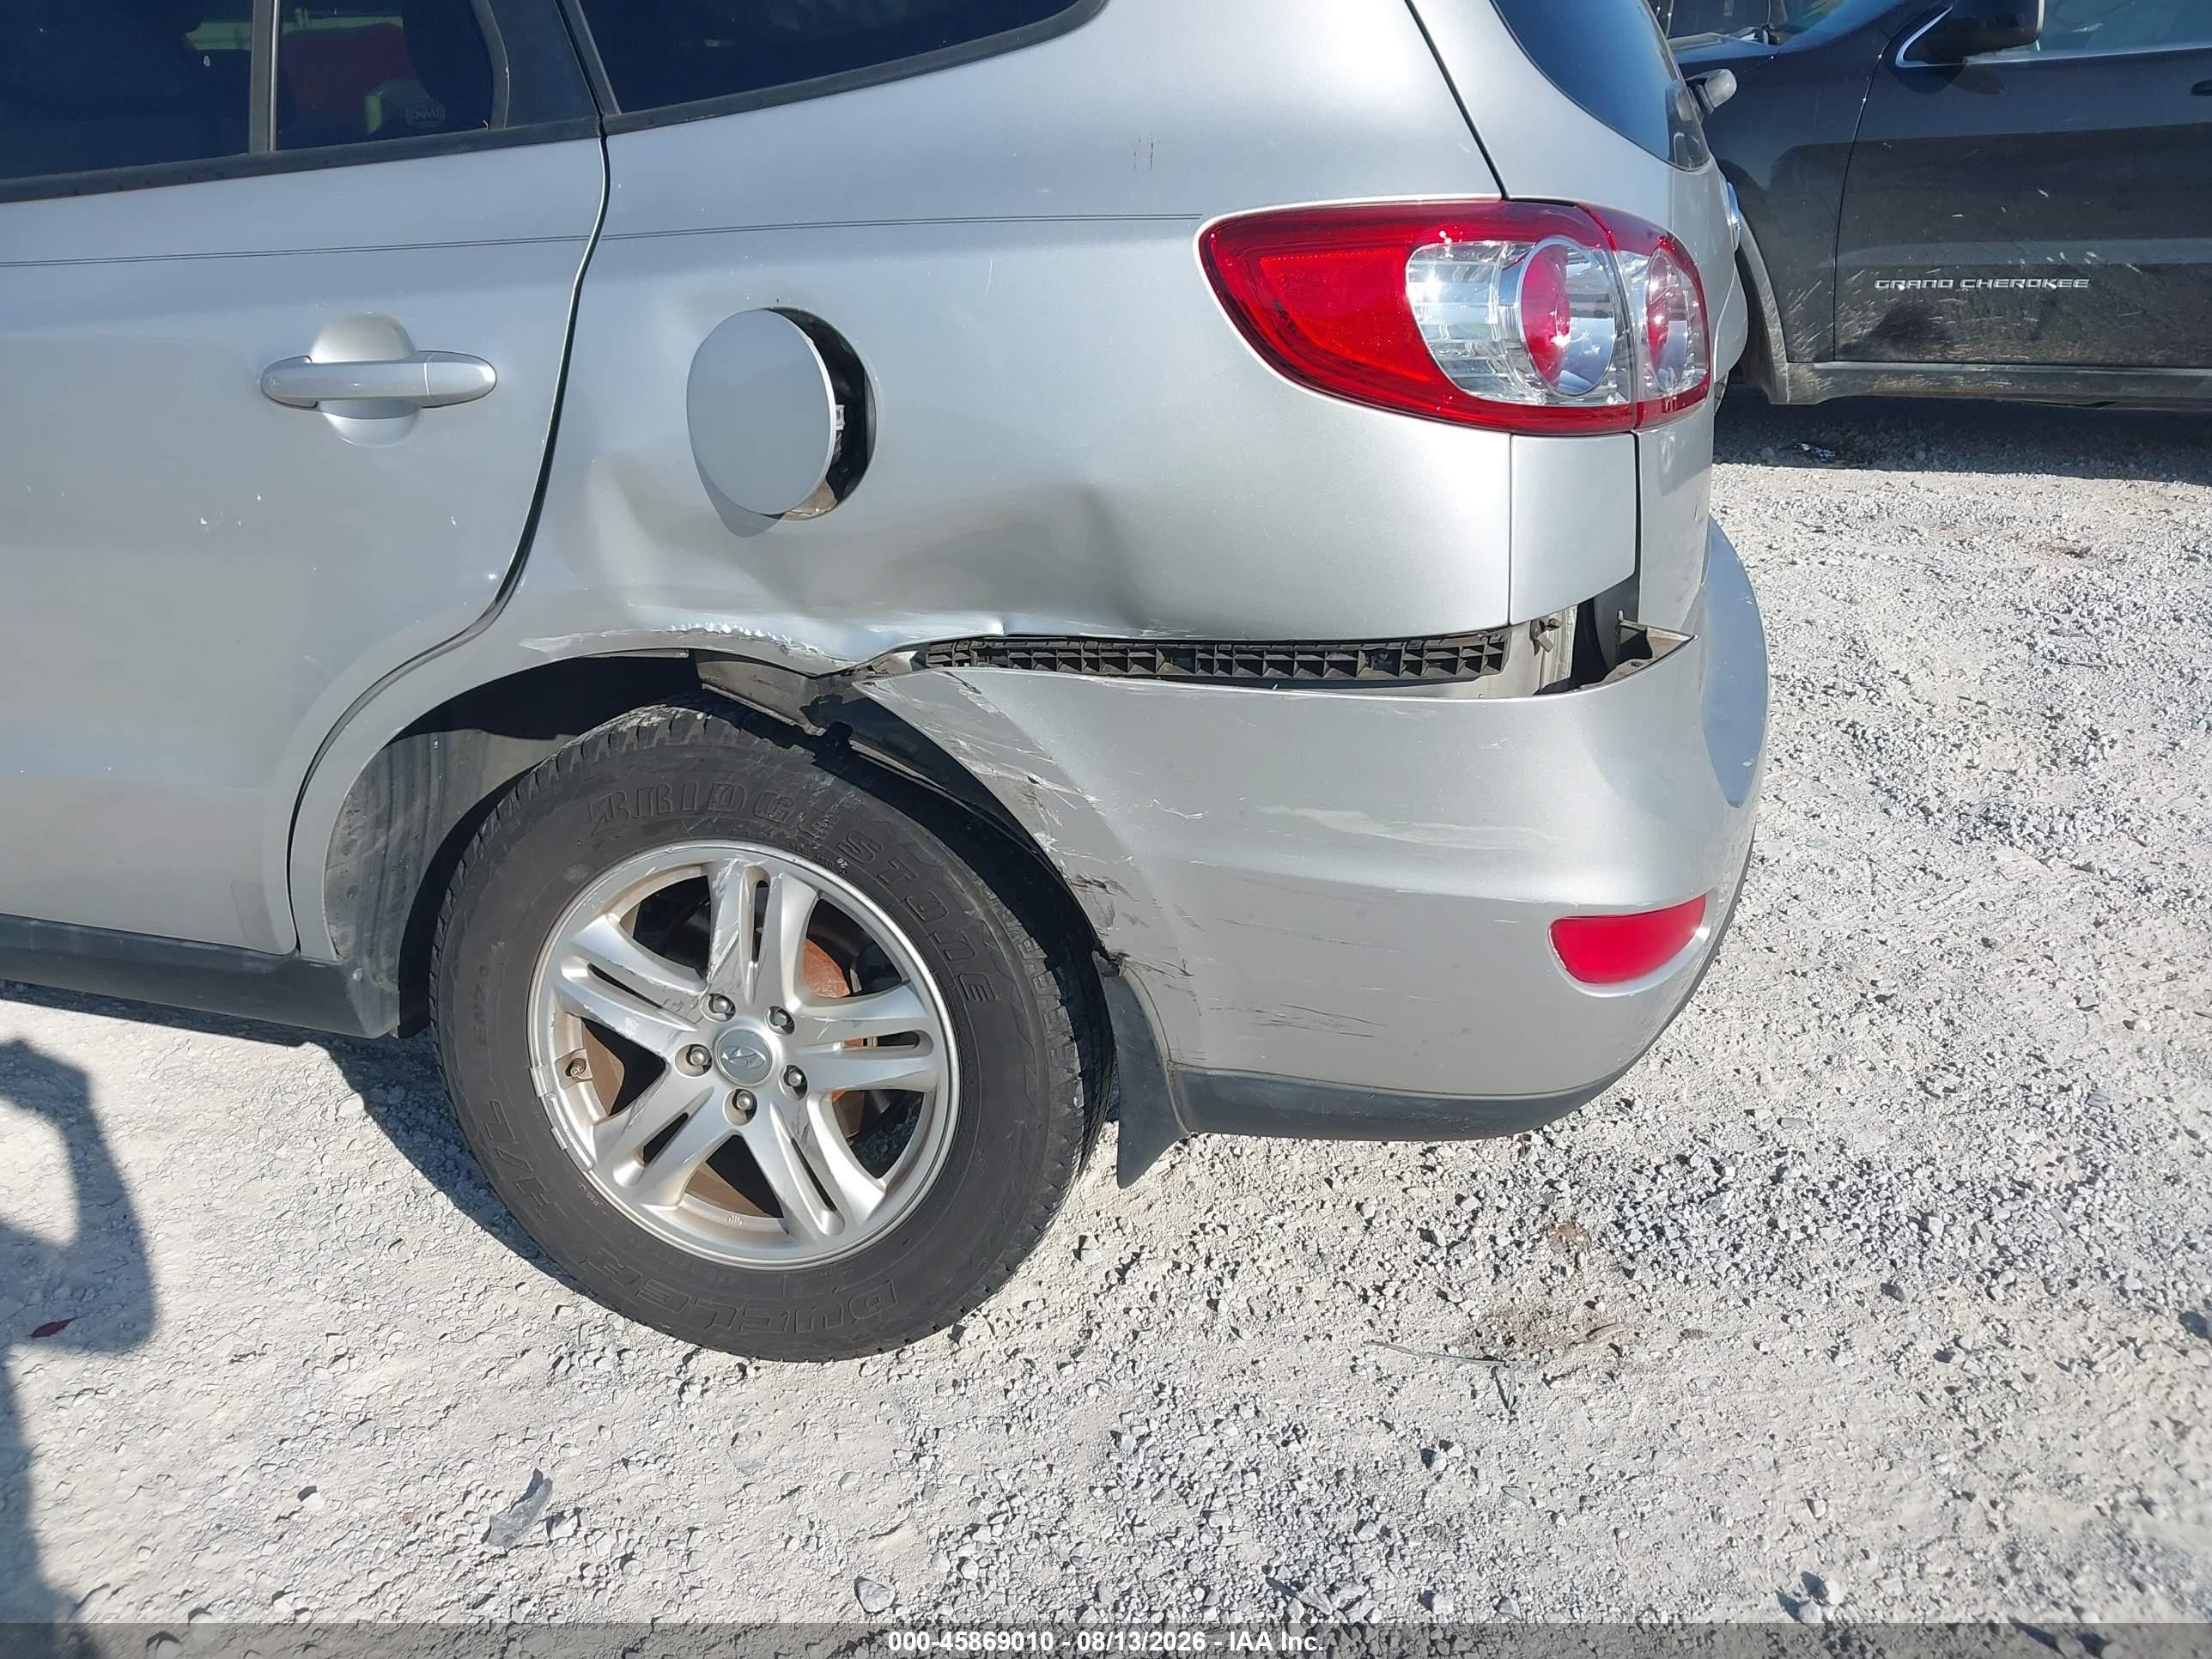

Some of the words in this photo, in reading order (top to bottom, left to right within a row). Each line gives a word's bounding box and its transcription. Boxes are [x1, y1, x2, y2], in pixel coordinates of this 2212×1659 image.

[1874, 278, 1954, 289] GRAND
[1960, 278, 2090, 289] CHEROKEE
[588, 782, 996, 1003] BRIDGESTONE
[579, 1249, 898, 1334] DUELER
